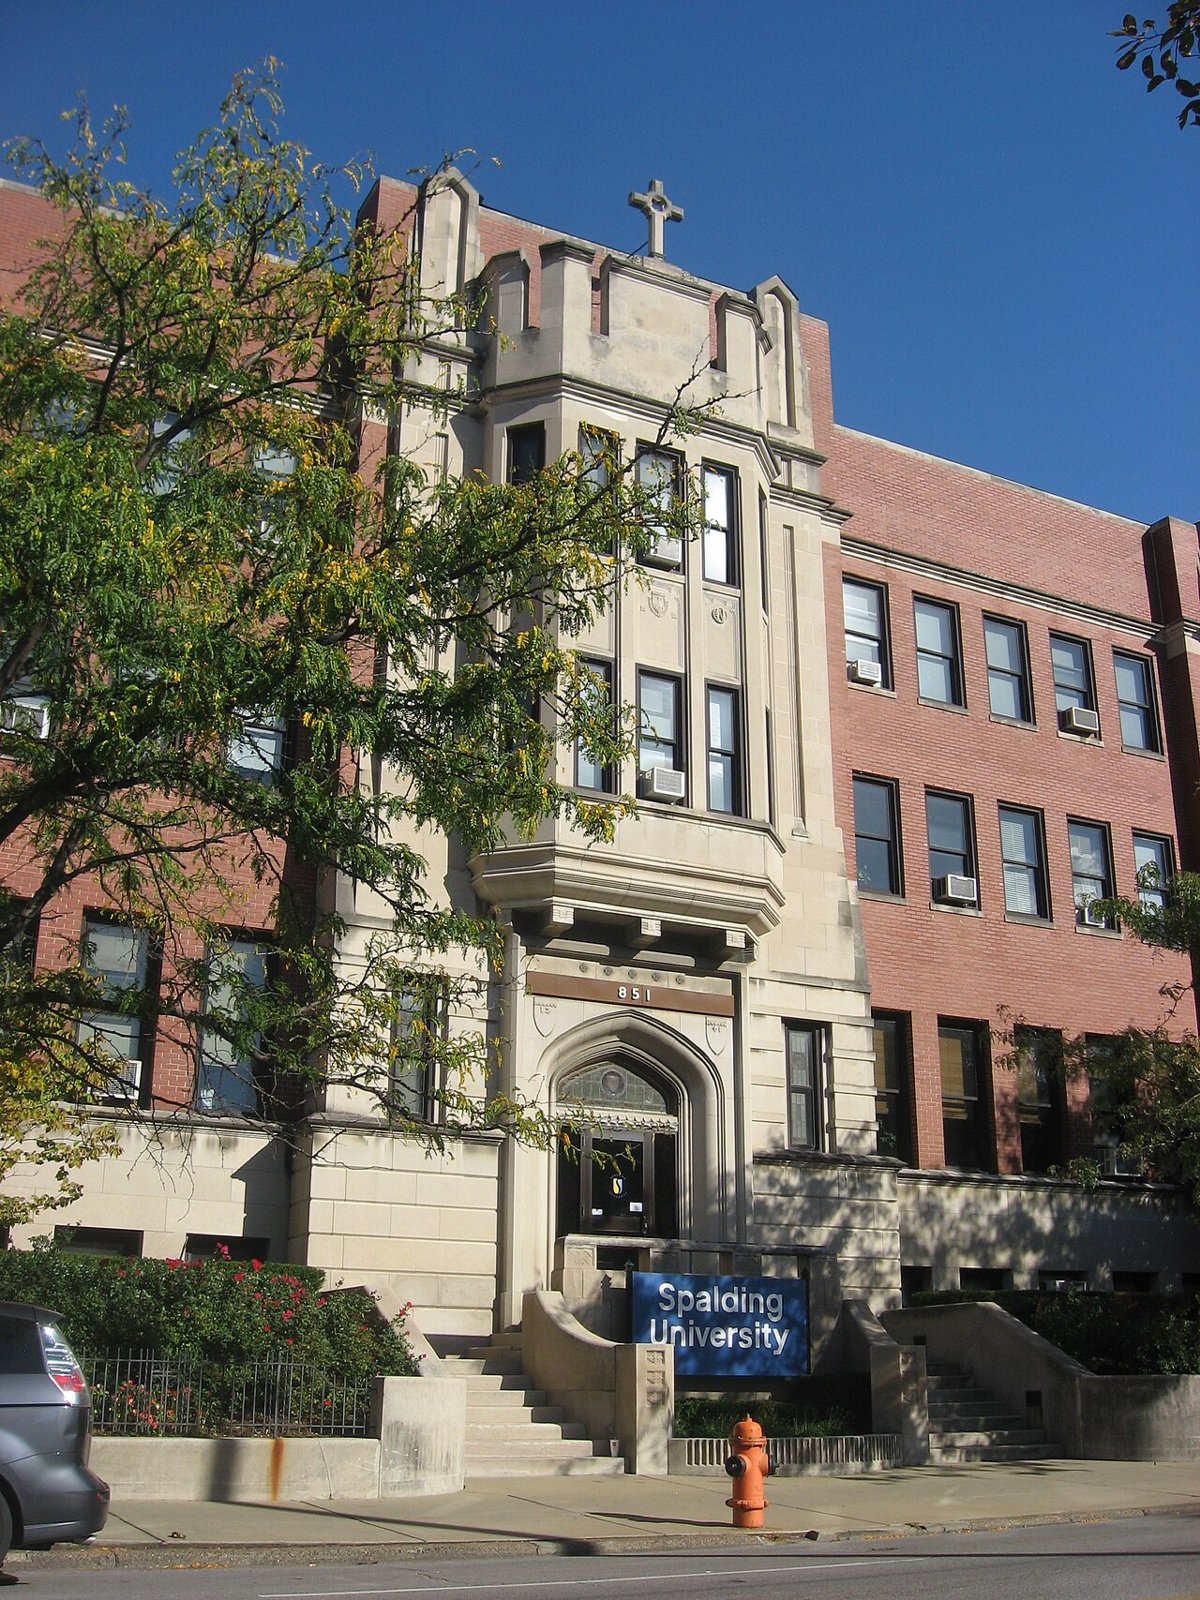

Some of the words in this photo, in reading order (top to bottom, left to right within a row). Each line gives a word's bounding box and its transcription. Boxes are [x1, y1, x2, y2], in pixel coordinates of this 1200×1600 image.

[617, 985, 651, 1002] 851
[658, 1282, 783, 1322] Spalding
[650, 1319, 790, 1356] University
